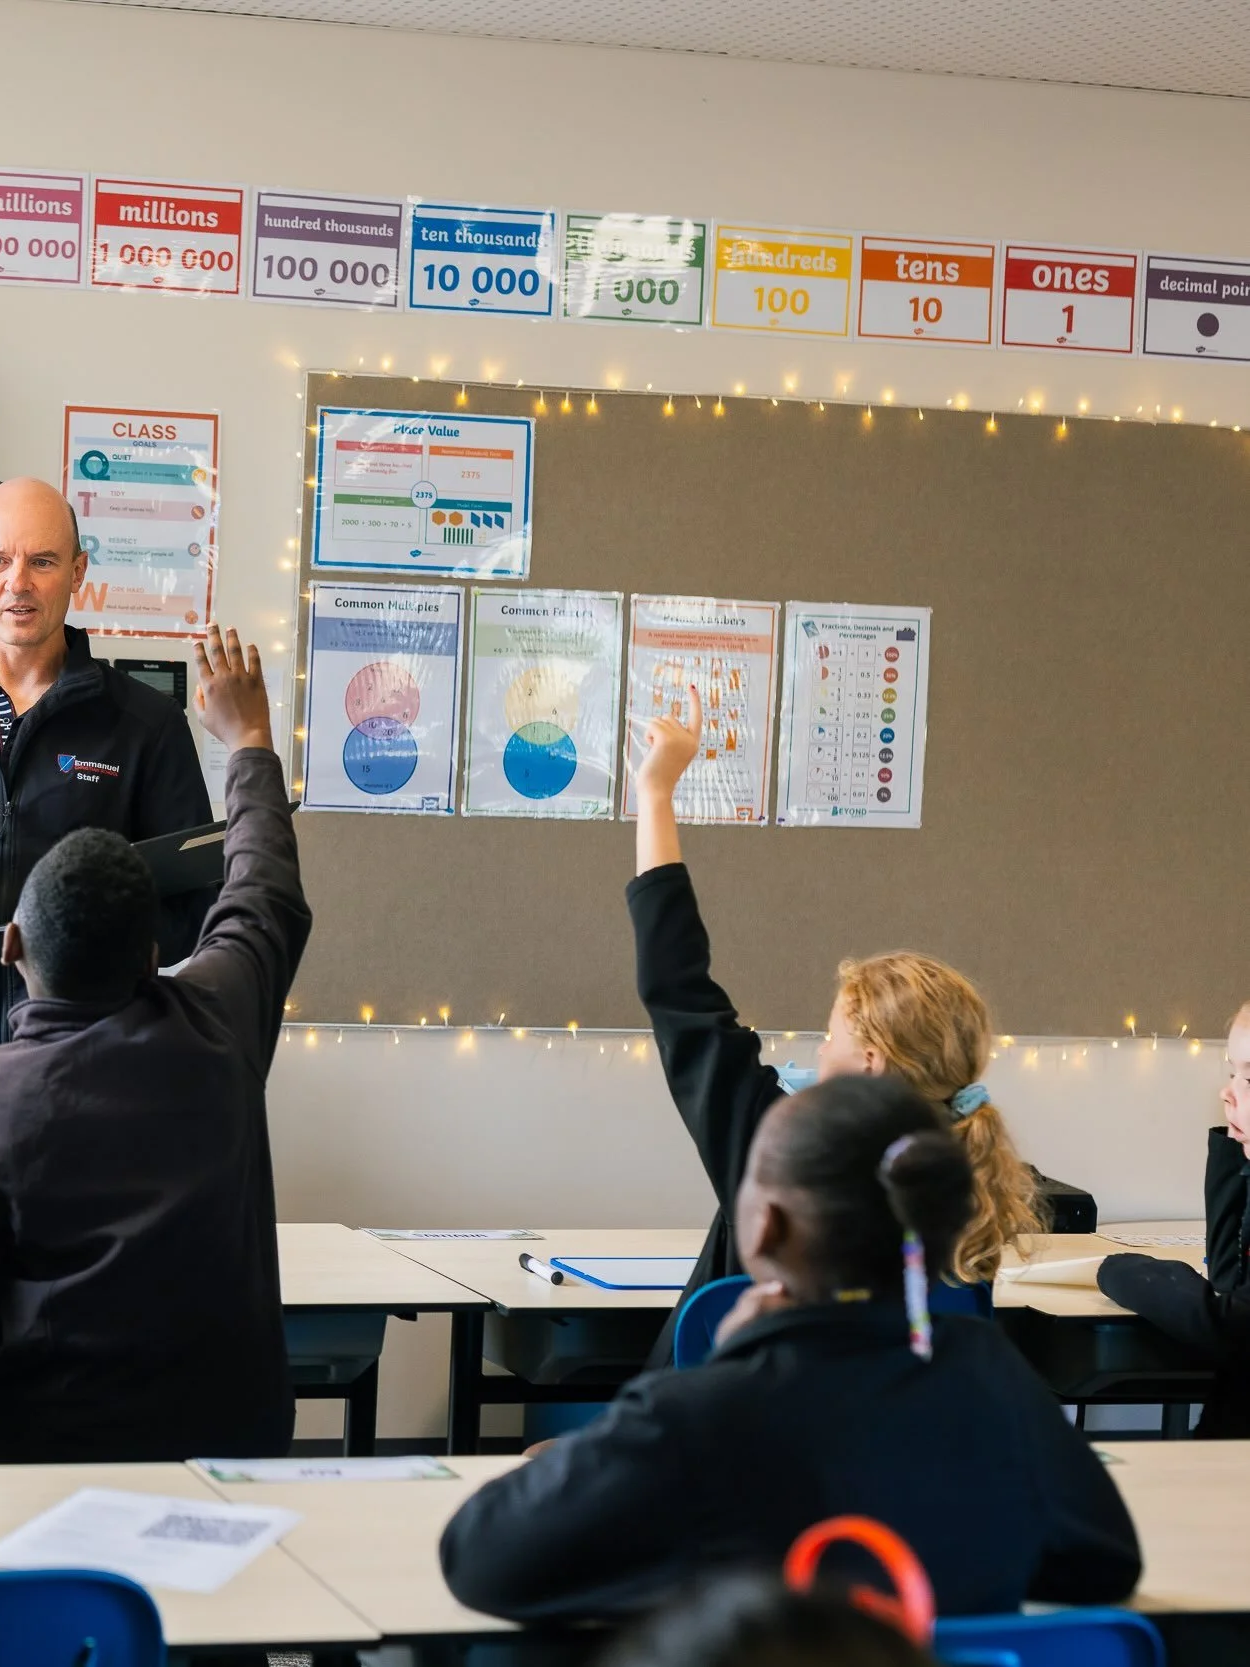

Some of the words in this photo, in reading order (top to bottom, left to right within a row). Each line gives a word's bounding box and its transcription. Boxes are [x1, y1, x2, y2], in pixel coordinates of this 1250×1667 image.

[118, 201, 219, 229] millions
[263, 214, 321, 231] hundred
[325, 218, 394, 237] thousands
[421, 227, 450, 243] ten
[28, 238, 77, 259] 000
[100, 243, 109, 264] 1
[119, 244, 172, 268] 000
[181, 248, 234, 272] 000
[730, 242, 837, 273] hundreds
[263, 254, 318, 281] 100
[329, 260, 390, 288] 000
[895, 254, 960, 283] tens
[423, 264, 460, 292] 10
[472, 266, 540, 296] 000
[1031, 264, 1110, 293] ones
[1159, 276, 1217, 295] decimal
[613, 278, 679, 305] 000
[754, 286, 810, 315] 100
[909, 296, 943, 323] 10
[1062, 304, 1075, 333] 1
[112, 422, 177, 440] CLASS
[393, 424, 425, 436] Place
[428, 425, 460, 438] Value
[132, 440, 157, 448] GOALS
[80, 450, 110, 480] Q
[461, 470, 481, 480] 2375
[415, 491, 433, 499] 2375
[341, 518, 359, 526] 2000
[368, 520, 382, 528] 300
[81, 535, 101, 565] R
[72, 582, 108, 612] W
[335, 597, 384, 610] Common
[501, 605, 549, 616] Common
[839, 632, 876, 640] Percentages
[853, 624, 881, 632] Decimals
[527, 688, 533, 697] 2
[368, 721, 377, 729] 10
[382, 728, 393, 737] 20
[75, 759, 120, 773] Emmanuel
[362, 764, 371, 773] 15
[76, 772, 100, 783] Staff
